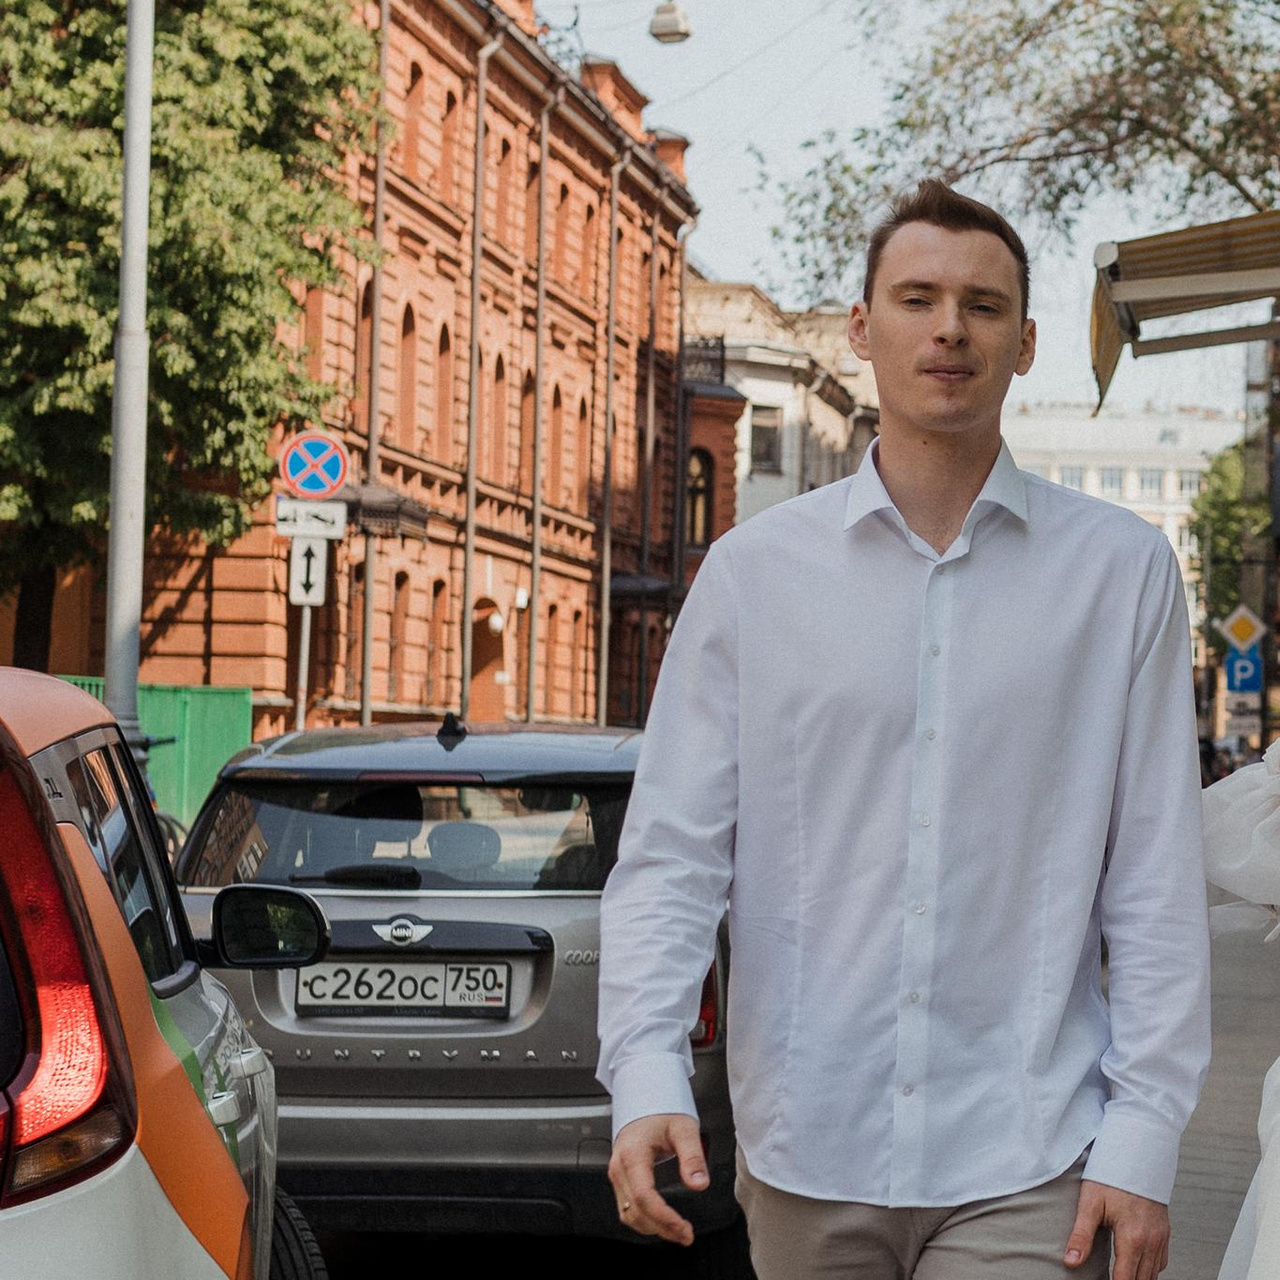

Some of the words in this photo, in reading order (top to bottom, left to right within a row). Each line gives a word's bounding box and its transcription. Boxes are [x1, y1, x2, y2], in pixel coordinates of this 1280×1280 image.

[1234, 659, 1255, 688] P
[392, 927, 413, 939] MINI
[449, 967, 498, 992] 750
[459, 992, 484, 1003] RUS
